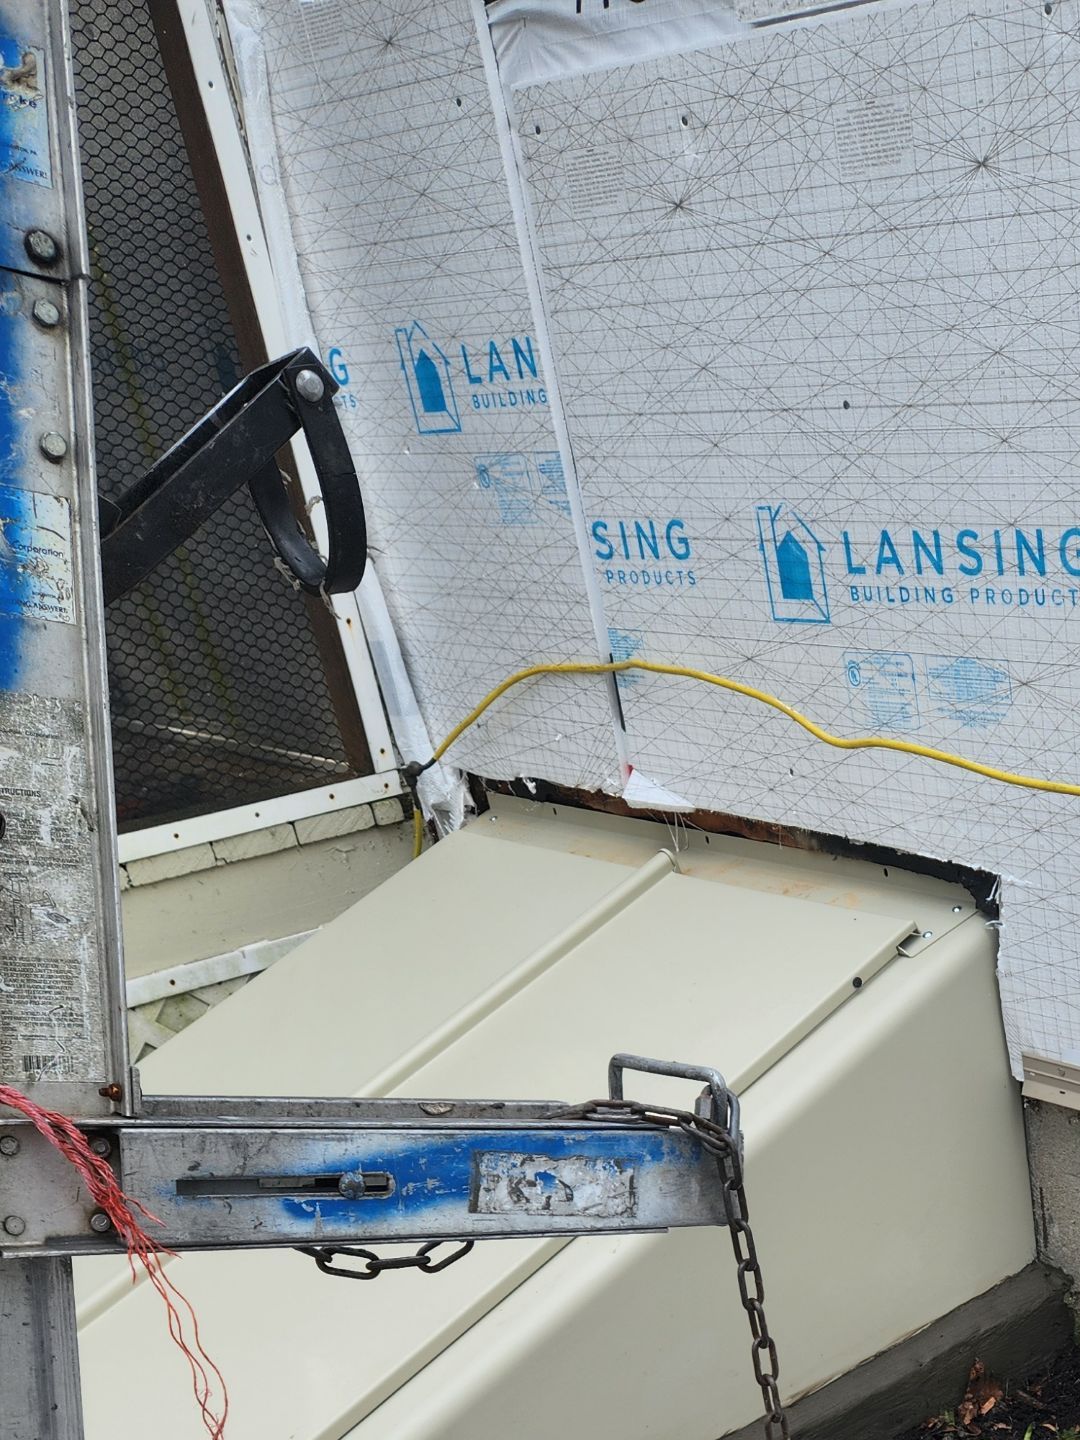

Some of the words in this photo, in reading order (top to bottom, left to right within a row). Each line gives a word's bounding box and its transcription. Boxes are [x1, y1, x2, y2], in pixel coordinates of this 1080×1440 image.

[461, 336, 537, 384] LAN
[472, 388, 547, 409] BUILDING
[591, 519, 691, 560] SING
[605, 569, 697, 585] PRODUCTS
[850, 585, 955, 604] BUILDING
